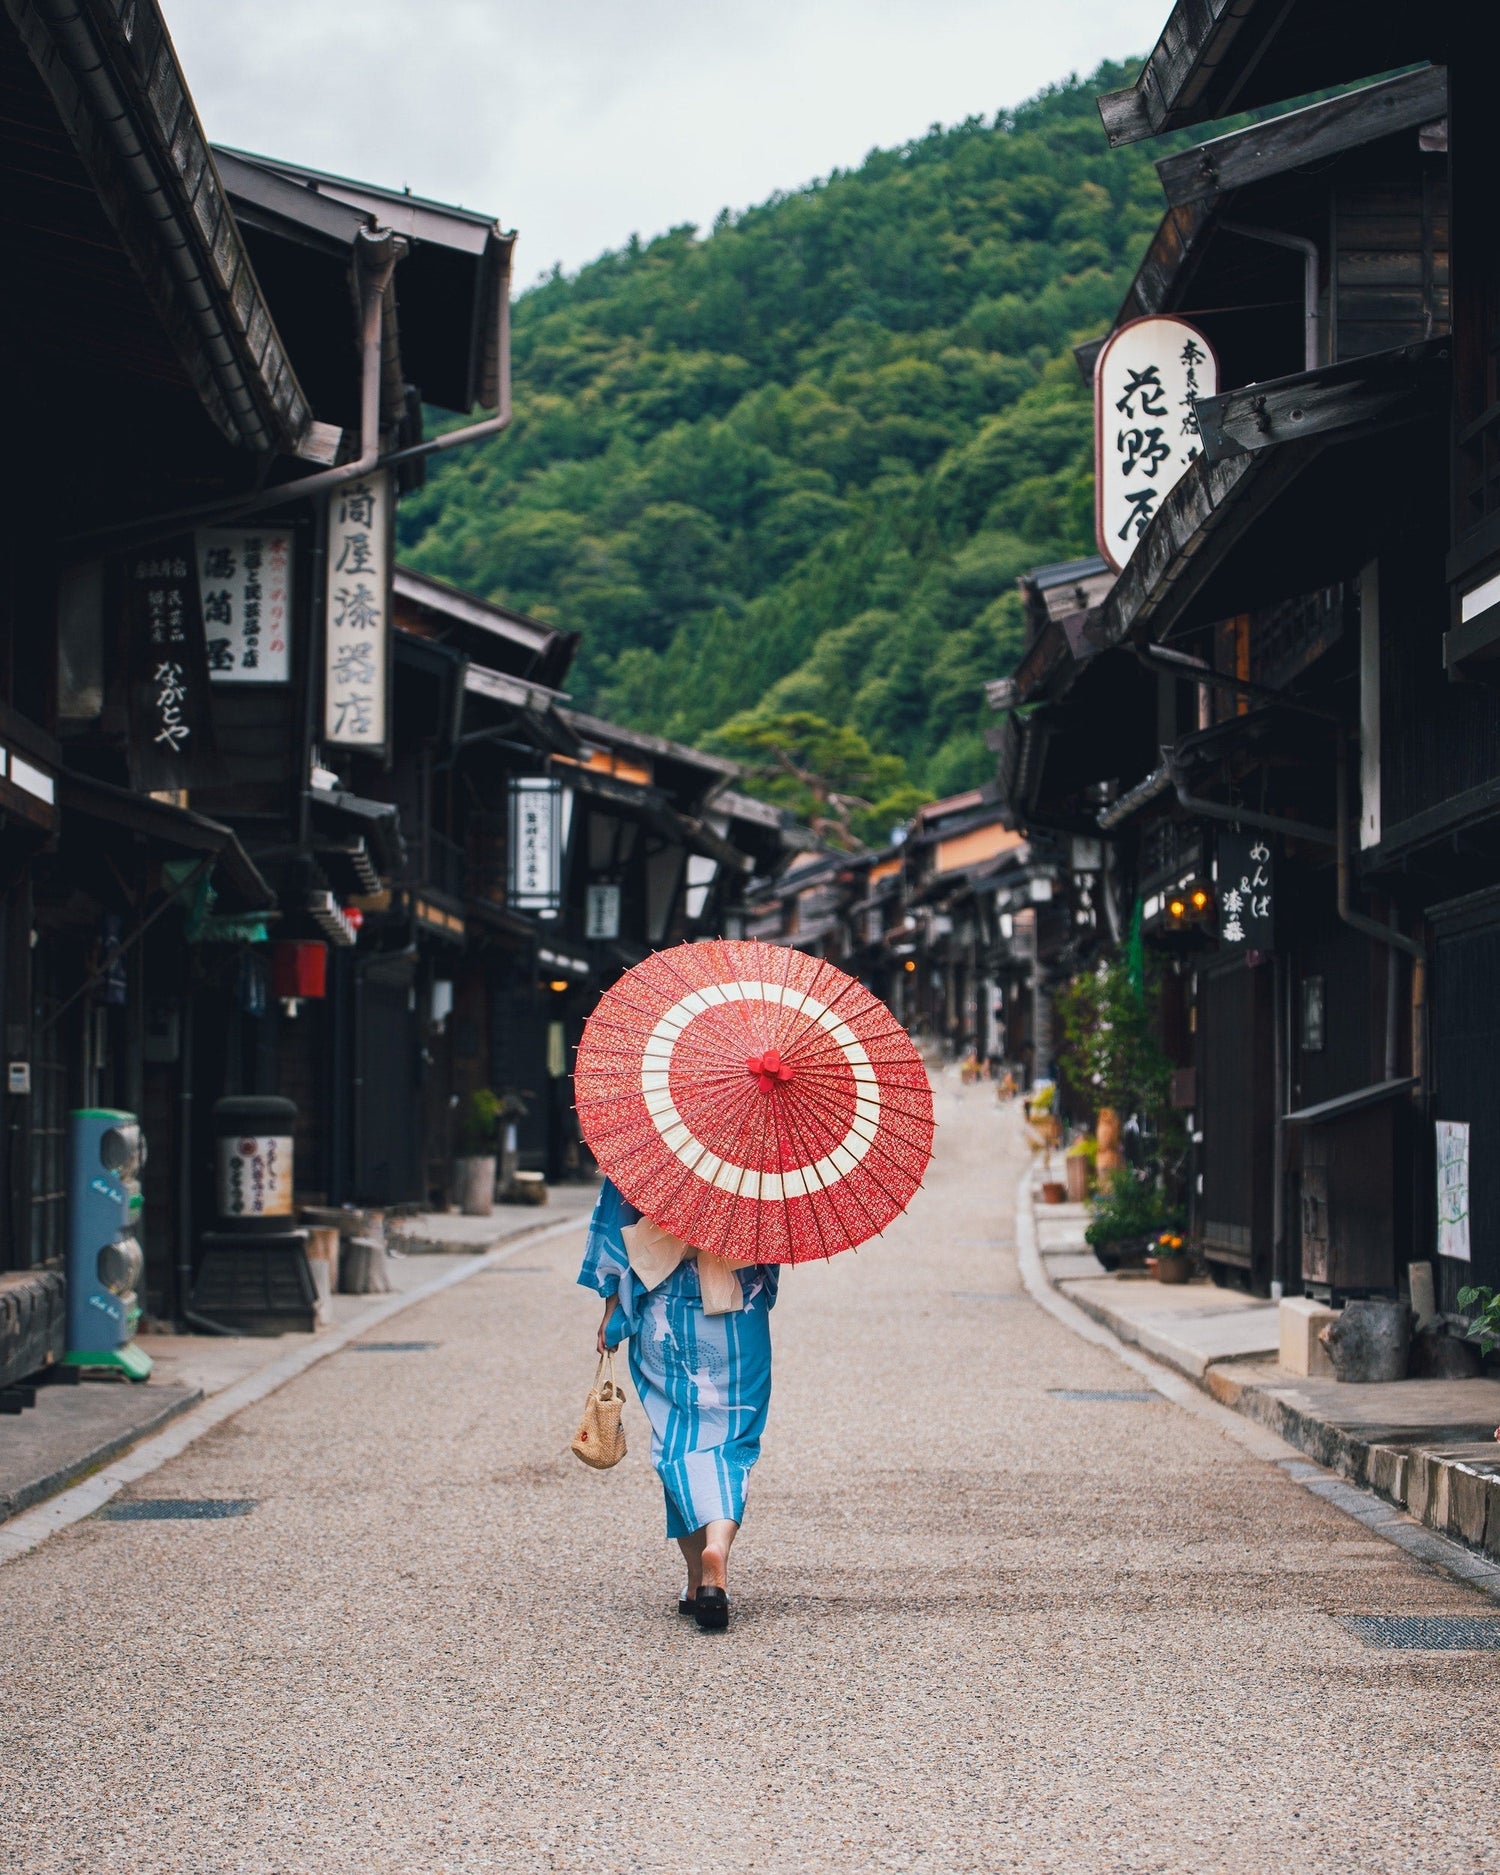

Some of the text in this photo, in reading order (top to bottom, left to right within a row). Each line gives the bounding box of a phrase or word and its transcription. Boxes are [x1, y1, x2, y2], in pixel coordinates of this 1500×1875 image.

[332, 434, 380, 736] 筒屋漆器店
[153, 660, 191, 753] ながとや
